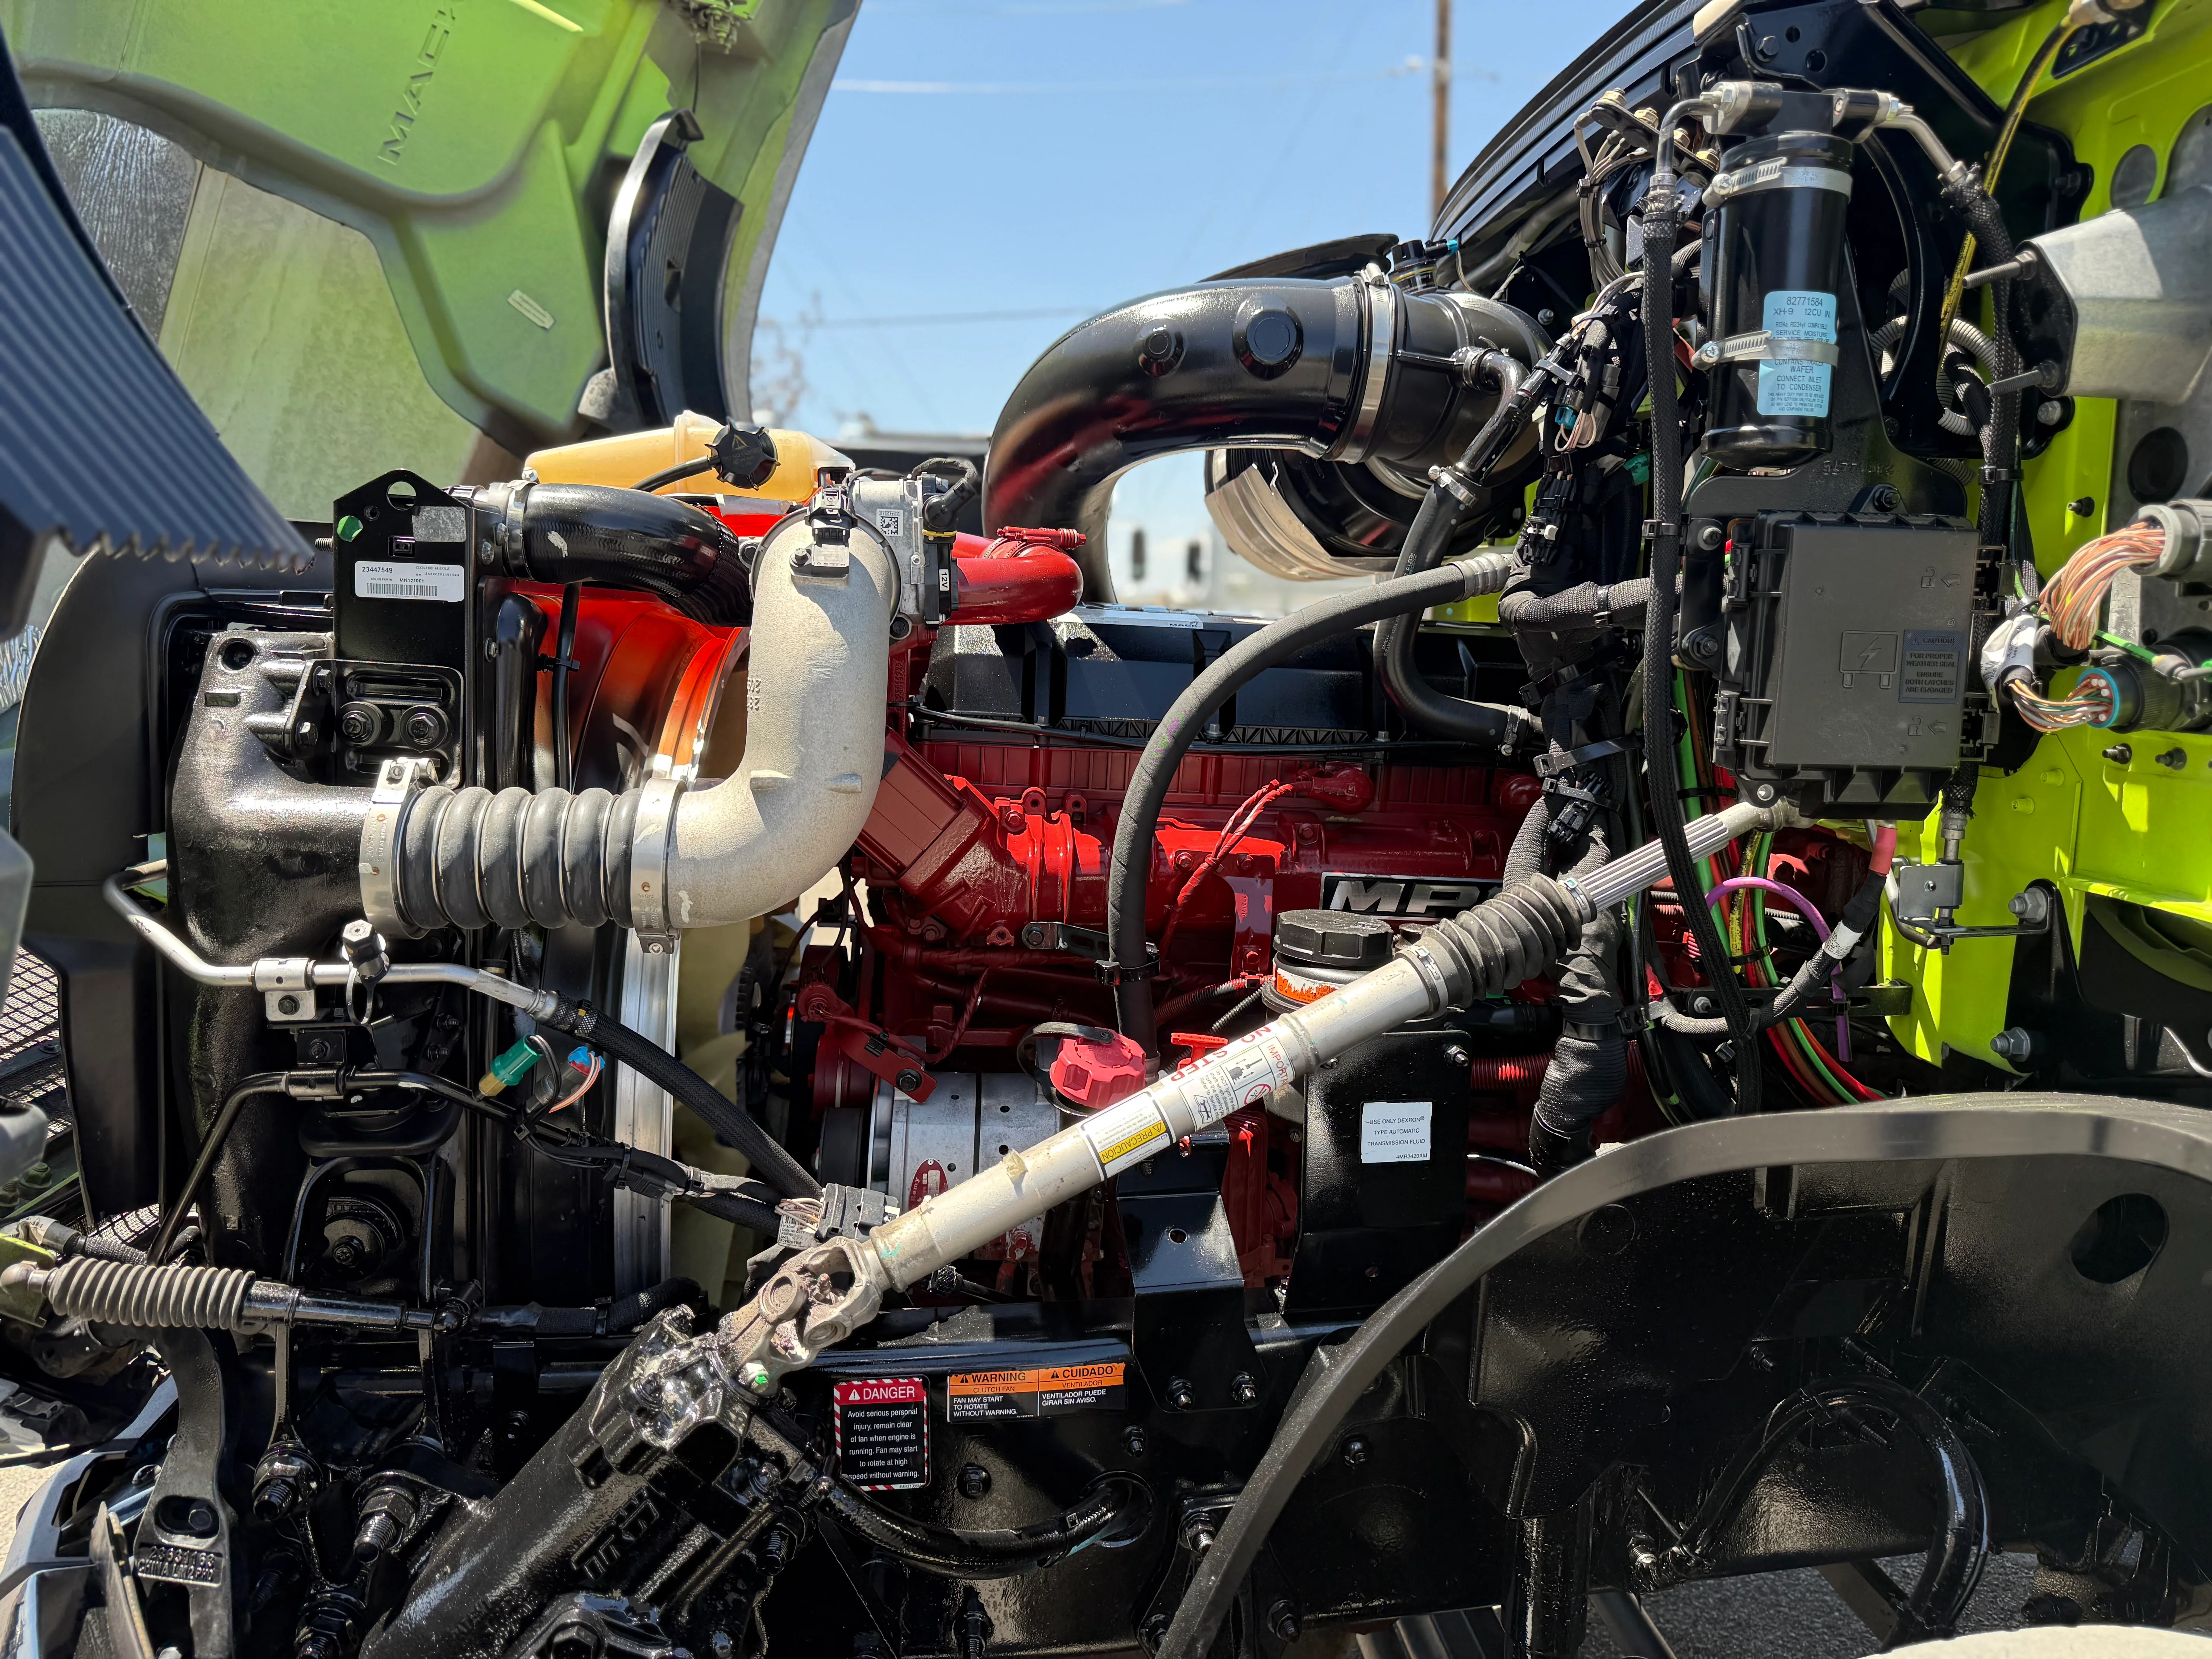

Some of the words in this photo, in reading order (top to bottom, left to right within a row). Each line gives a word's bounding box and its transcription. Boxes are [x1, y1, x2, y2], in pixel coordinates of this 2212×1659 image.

[1787, 297, 1822, 306] 82771584
[1329, 880, 1503, 913] MP
[1219, 1075, 1228, 1088] NOT
[1215, 1082, 1225, 1096] when
[1102, 1131, 1153, 1161] PRECAUCIÓN
[910, 1177, 920, 1201] Remy
[972, 1372, 1026, 1382] WARNING
[1063, 1366, 1113, 1378] CUIDADO
[863, 1386, 915, 1400] DANGER
[1042, 1391, 1083, 1399] VENTILADOR
[891, 1408, 917, 1417] personal
[854, 1423, 872, 1431] injury,
[888, 1434, 909, 1442] engine
[849, 1472, 868, 1481] speed
